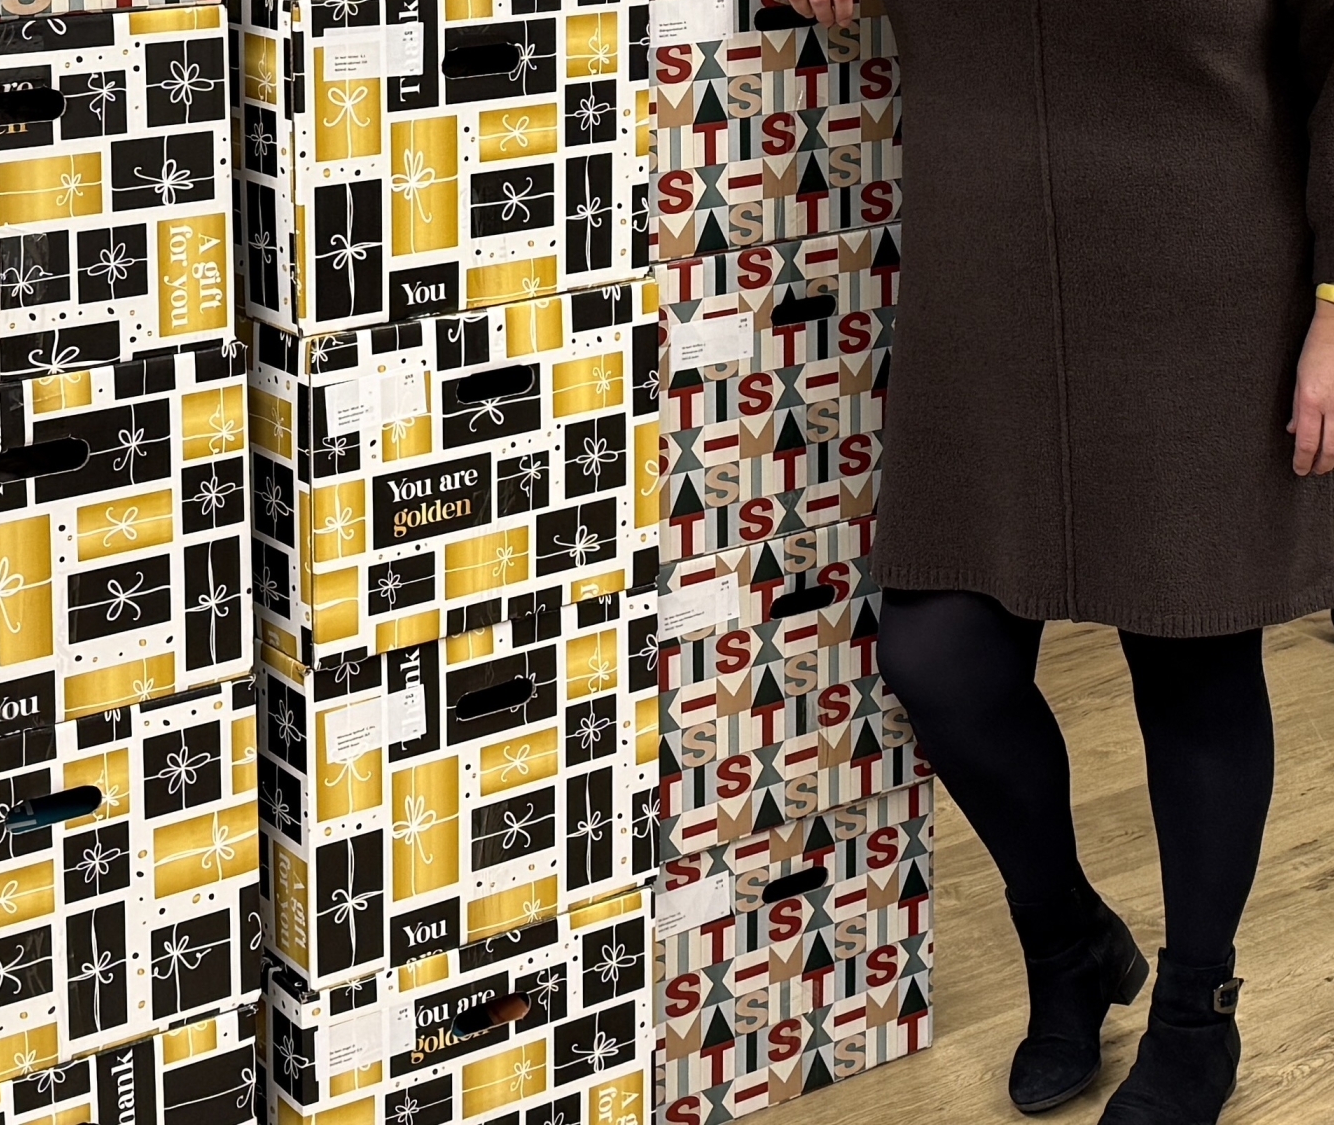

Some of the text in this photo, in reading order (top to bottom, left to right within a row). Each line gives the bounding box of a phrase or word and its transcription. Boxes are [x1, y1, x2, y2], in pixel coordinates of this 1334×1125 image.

[164, 225, 193, 329] for you
[192, 233, 222, 315] A gift
[402, 281, 447, 306] You
[387, 468, 479, 504] You are
[393, 498, 472, 538] golden
[402, 918, 448, 949] You
[411, 1026, 488, 1065] gold
